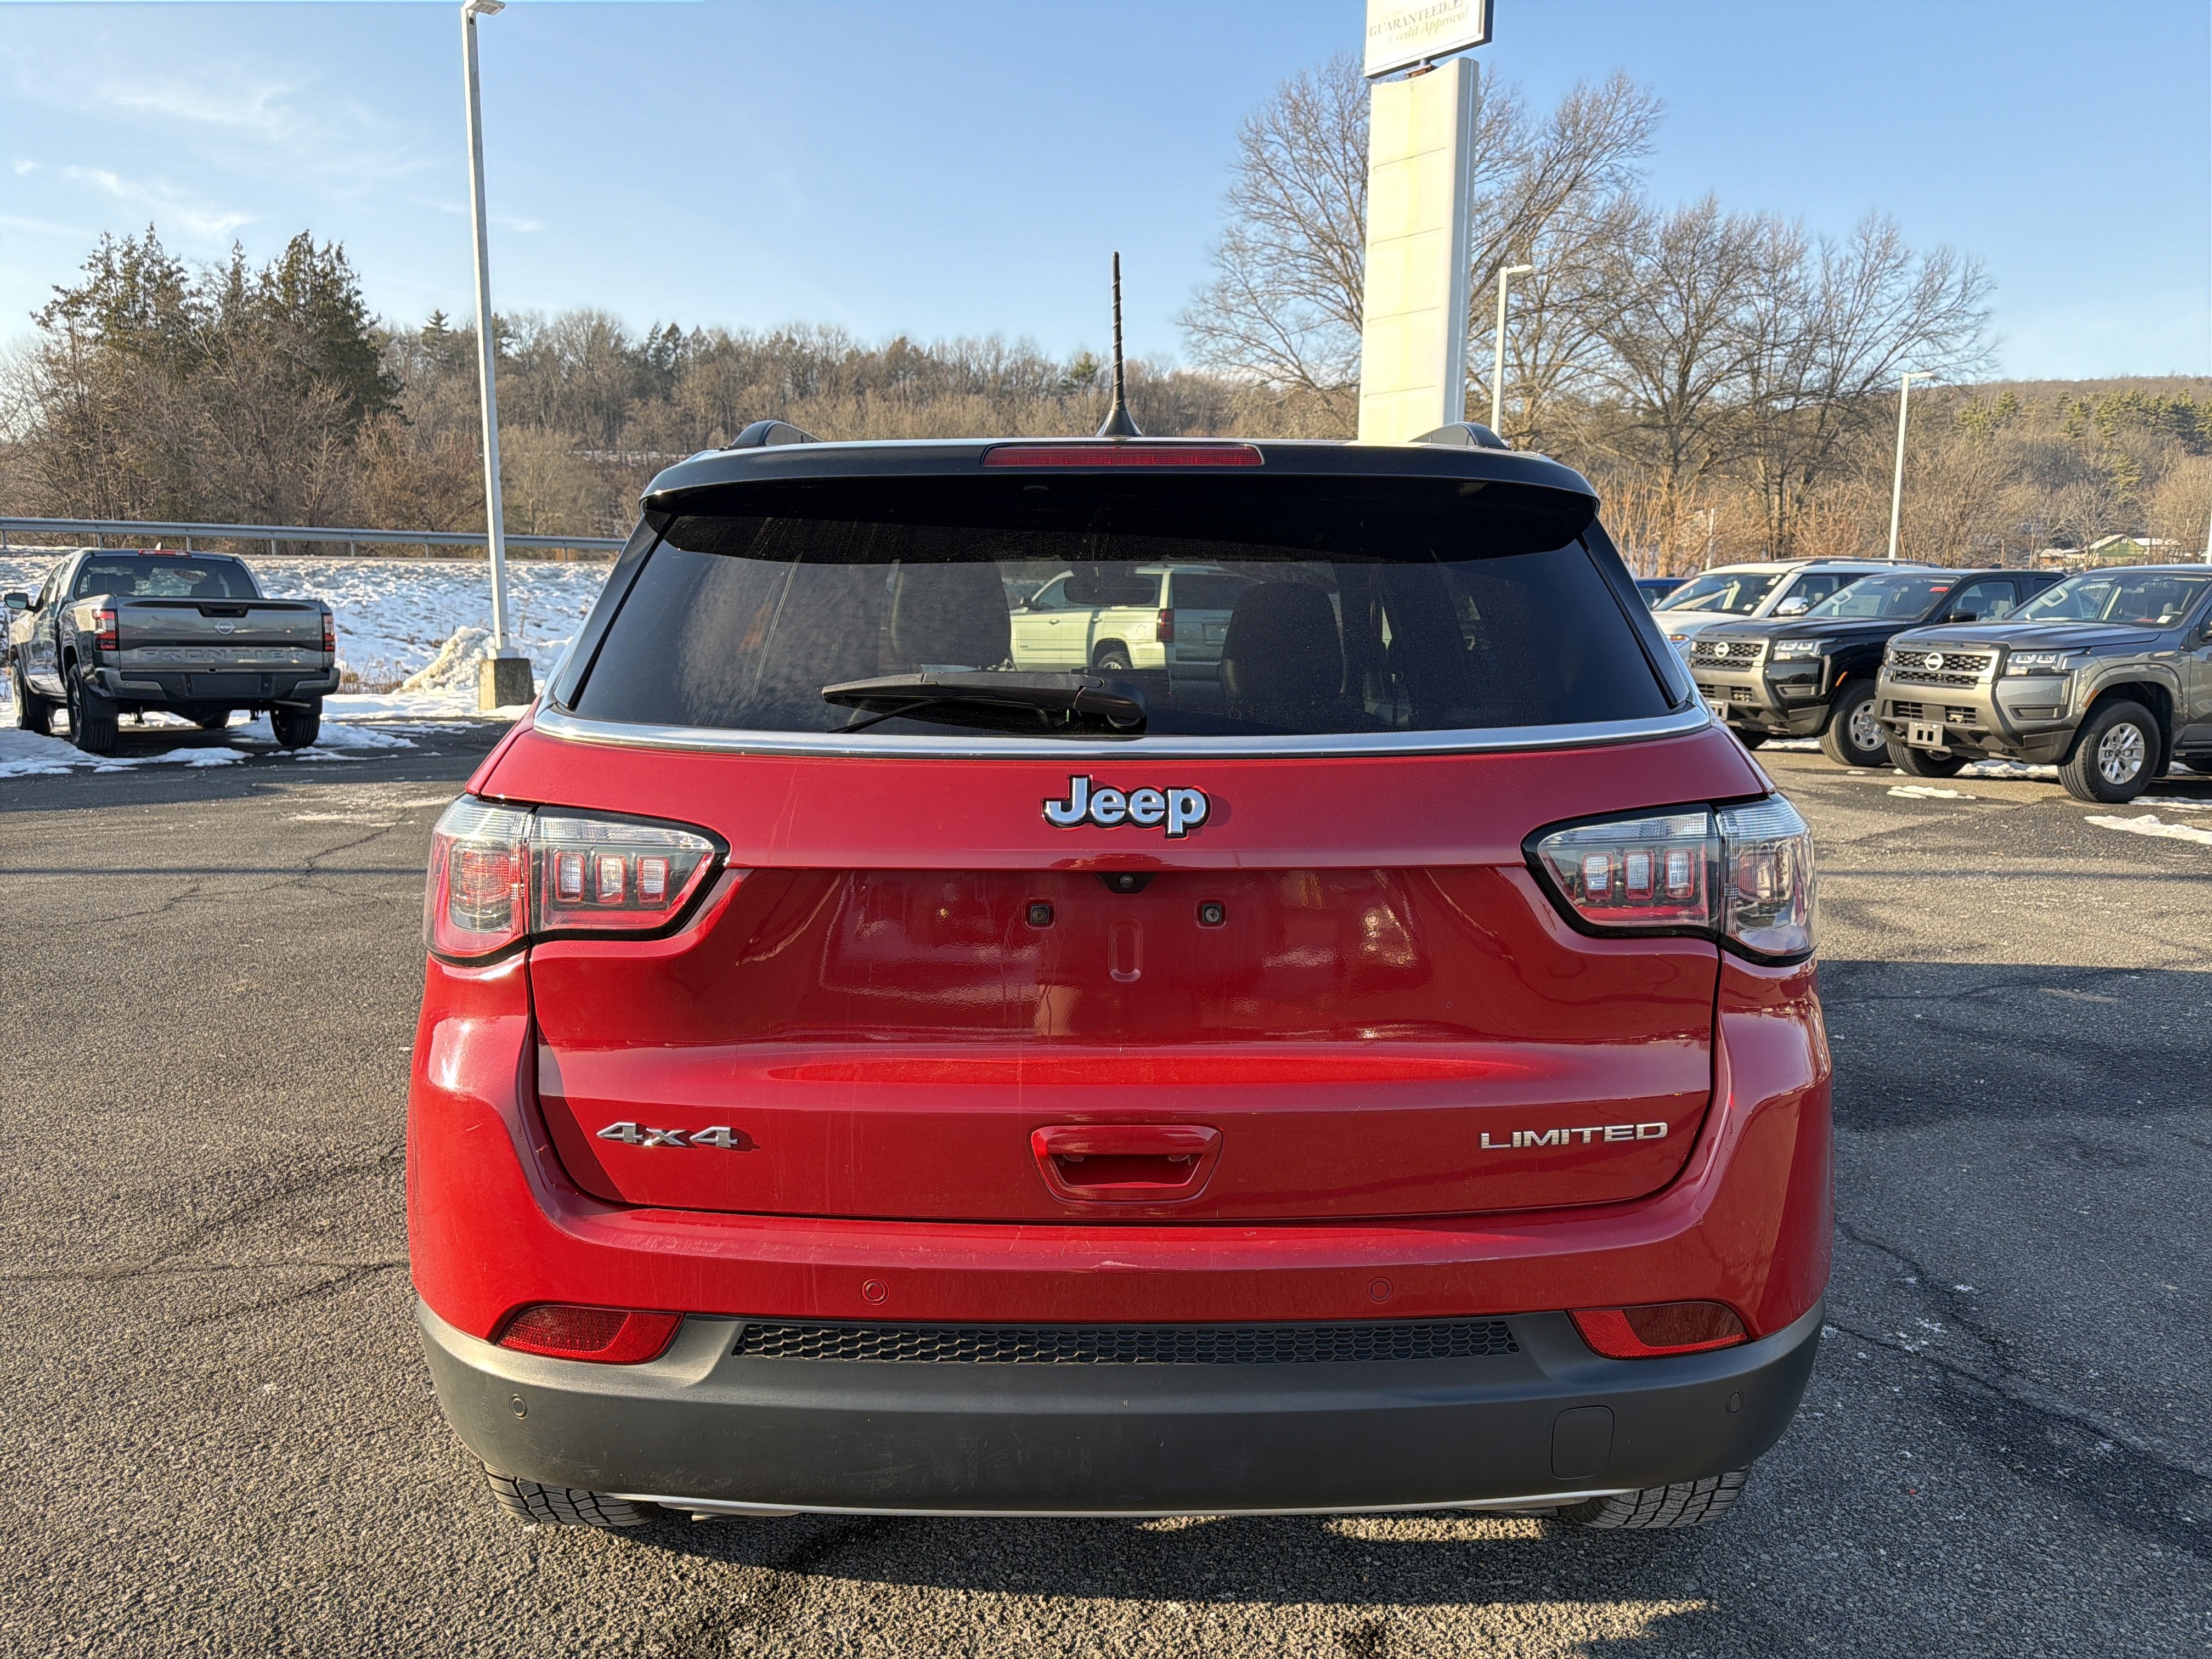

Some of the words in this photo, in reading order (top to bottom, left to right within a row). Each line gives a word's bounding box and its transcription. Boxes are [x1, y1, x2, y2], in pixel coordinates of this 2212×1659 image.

[1369, 2, 1447, 37] GUARANTEED
[1421, 6, 1469, 36] Approval
[139, 648, 308, 662] FRONTIER
[1042, 774, 1210, 838] Jeep
[596, 1121, 738, 1148] 4x4
[1480, 1122, 1668, 1149] LIMITED
